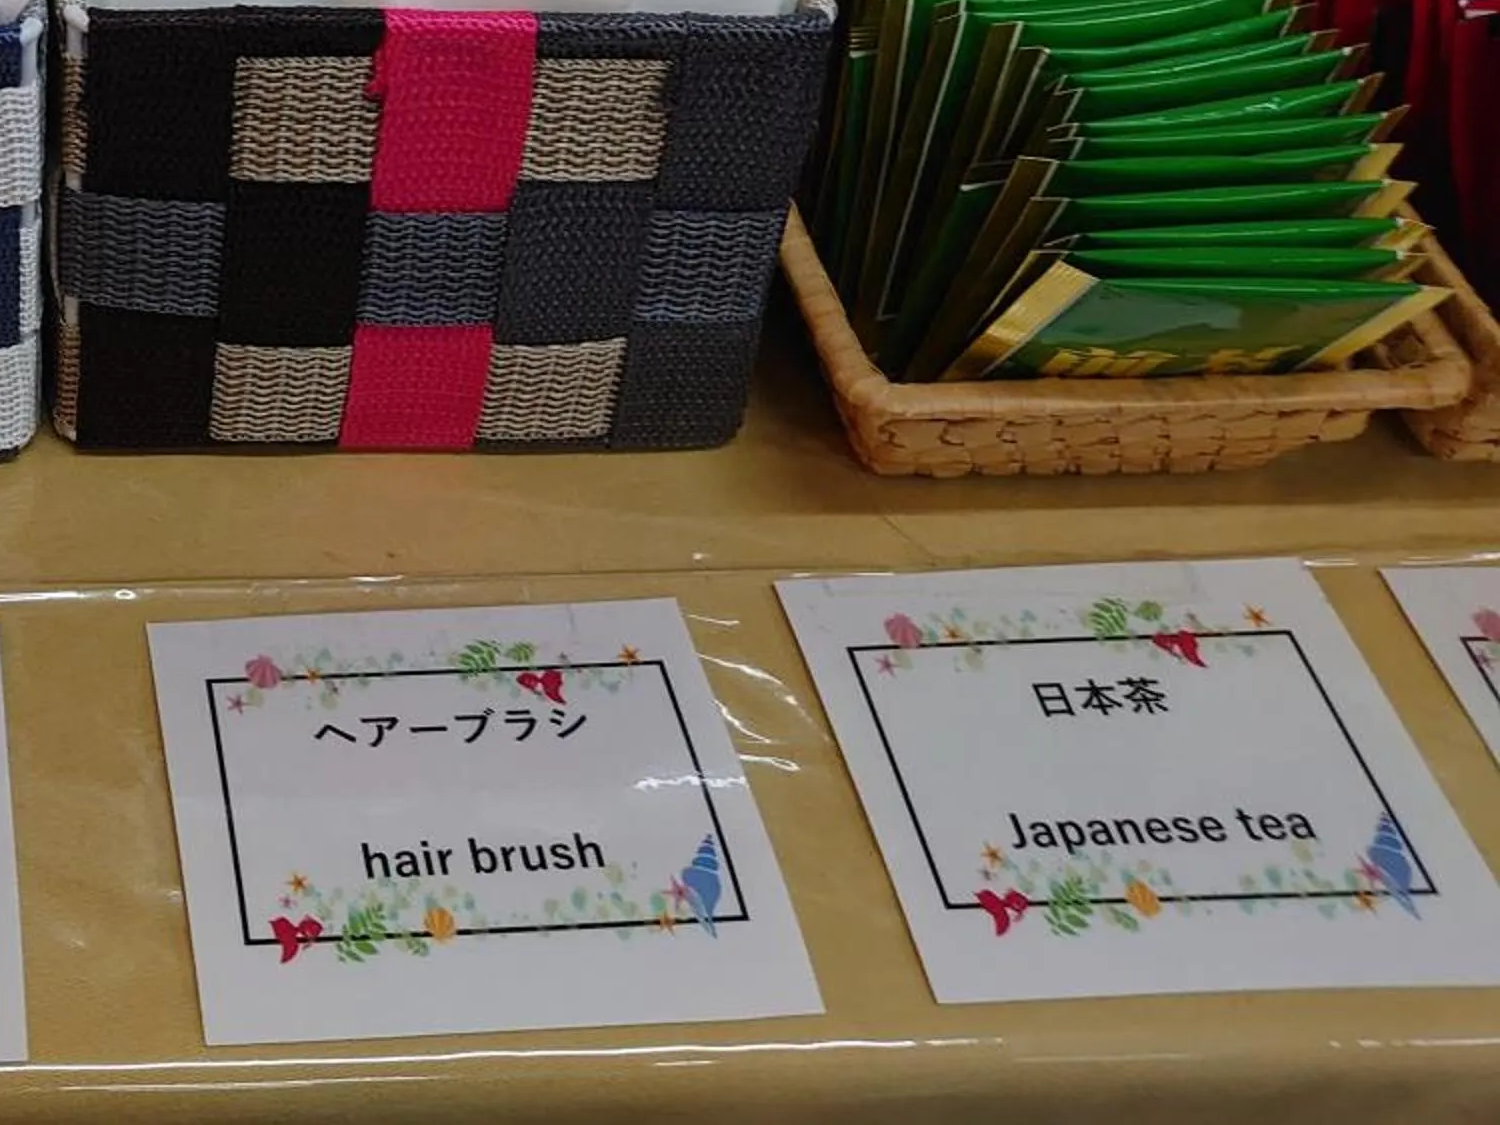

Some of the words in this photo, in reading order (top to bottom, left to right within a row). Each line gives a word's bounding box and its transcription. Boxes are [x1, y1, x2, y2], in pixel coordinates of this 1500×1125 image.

[1032, 678, 1170, 719] 日本茶
[314, 707, 588, 748] ヘアーブラシ
[1009, 812, 1227, 855] Japanese
[1235, 808, 1317, 841] tea
[361, 841, 453, 879] hair
[468, 832, 606, 875] brush
